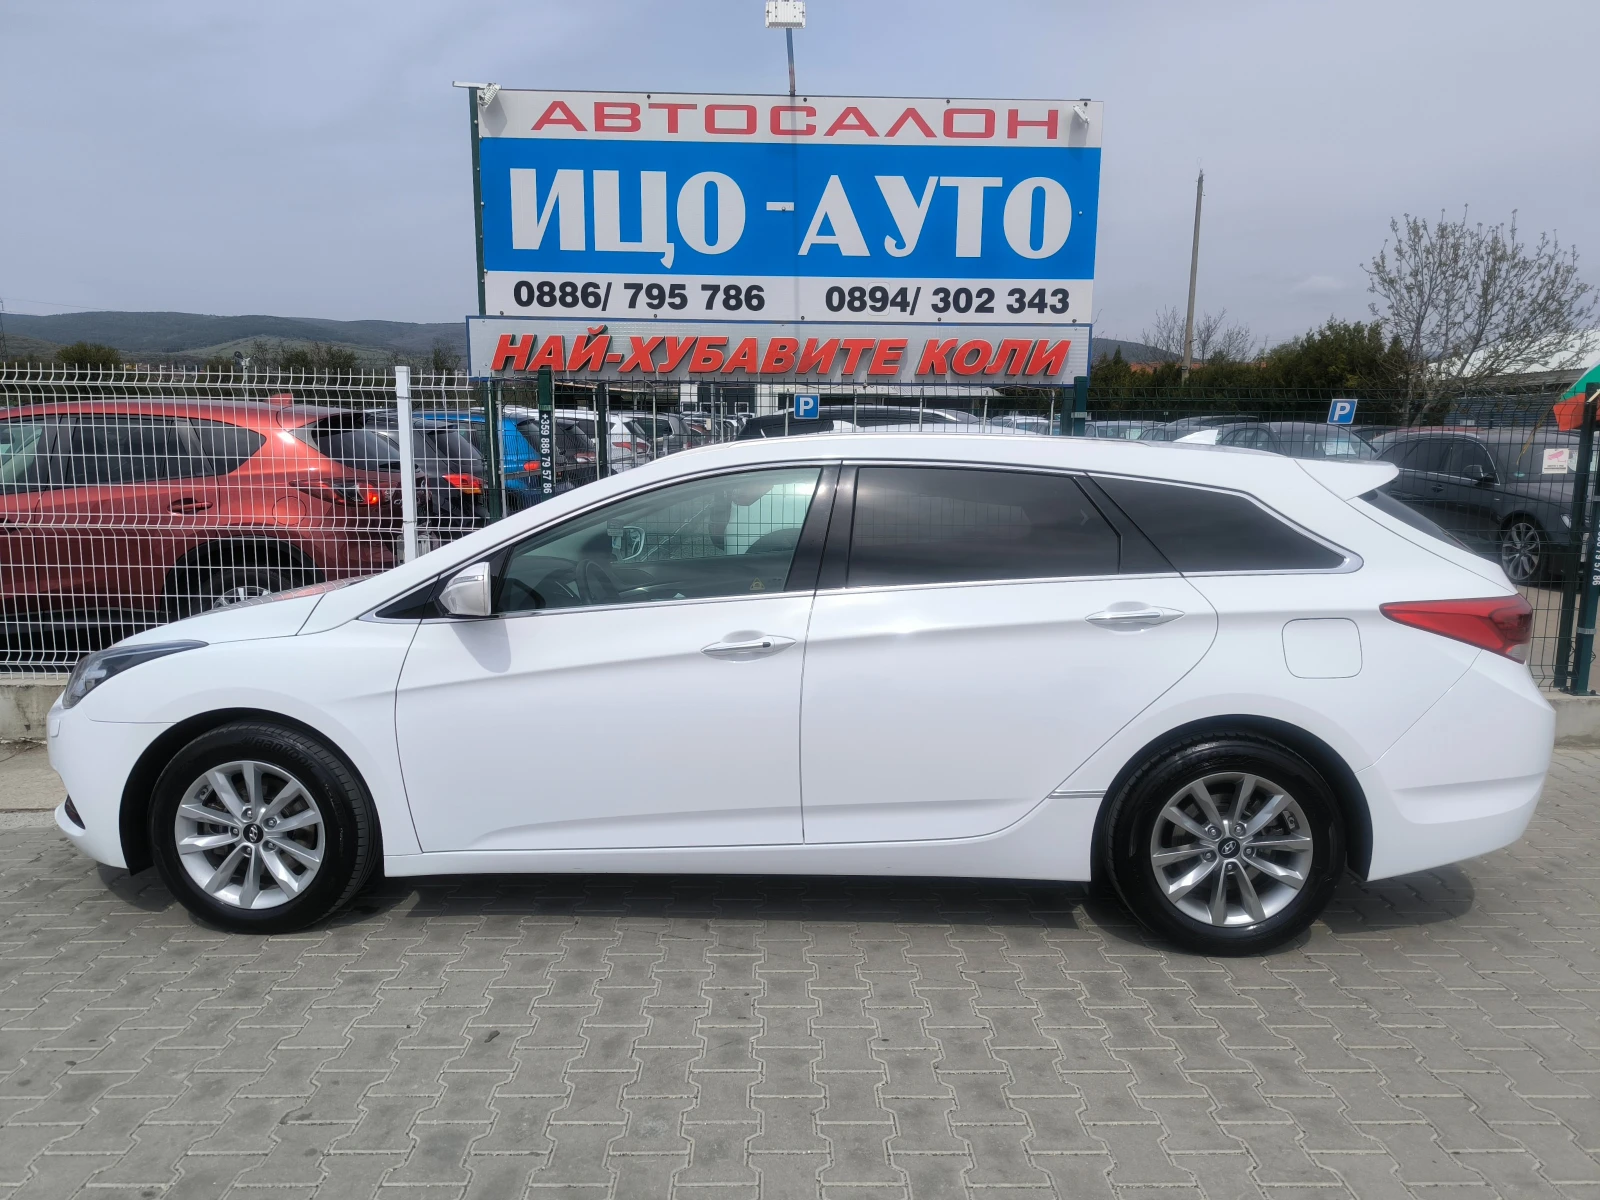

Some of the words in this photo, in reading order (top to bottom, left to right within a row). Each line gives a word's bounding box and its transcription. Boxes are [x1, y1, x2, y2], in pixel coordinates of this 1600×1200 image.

[532, 101, 1059, 140] АВТОСАЛОН
[510, 168, 746, 269] ИЦО
[798, 175, 1072, 260] АУТО
[513, 280, 613, 312] 0886/
[623, 282, 688, 311] 795
[700, 284, 765, 312] 786
[825, 285, 922, 316] 0894/
[931, 287, 995, 314] 302
[1006, 288, 1070, 315] 343
[490, 325, 909, 376] НАЙ-ХУБАВИТЕ
[915, 338, 1072, 377] КОЛИ
[799, 397, 814, 416] P
[1333, 402, 1351, 421] P
[540, 413, 550, 436] +359
[540, 437, 550, 454] 886
[541, 456, 551, 467] 79
[542, 469, 552, 480] 57
[543, 482, 552, 494] 86
[1592, 574, 1600, 586] 86
